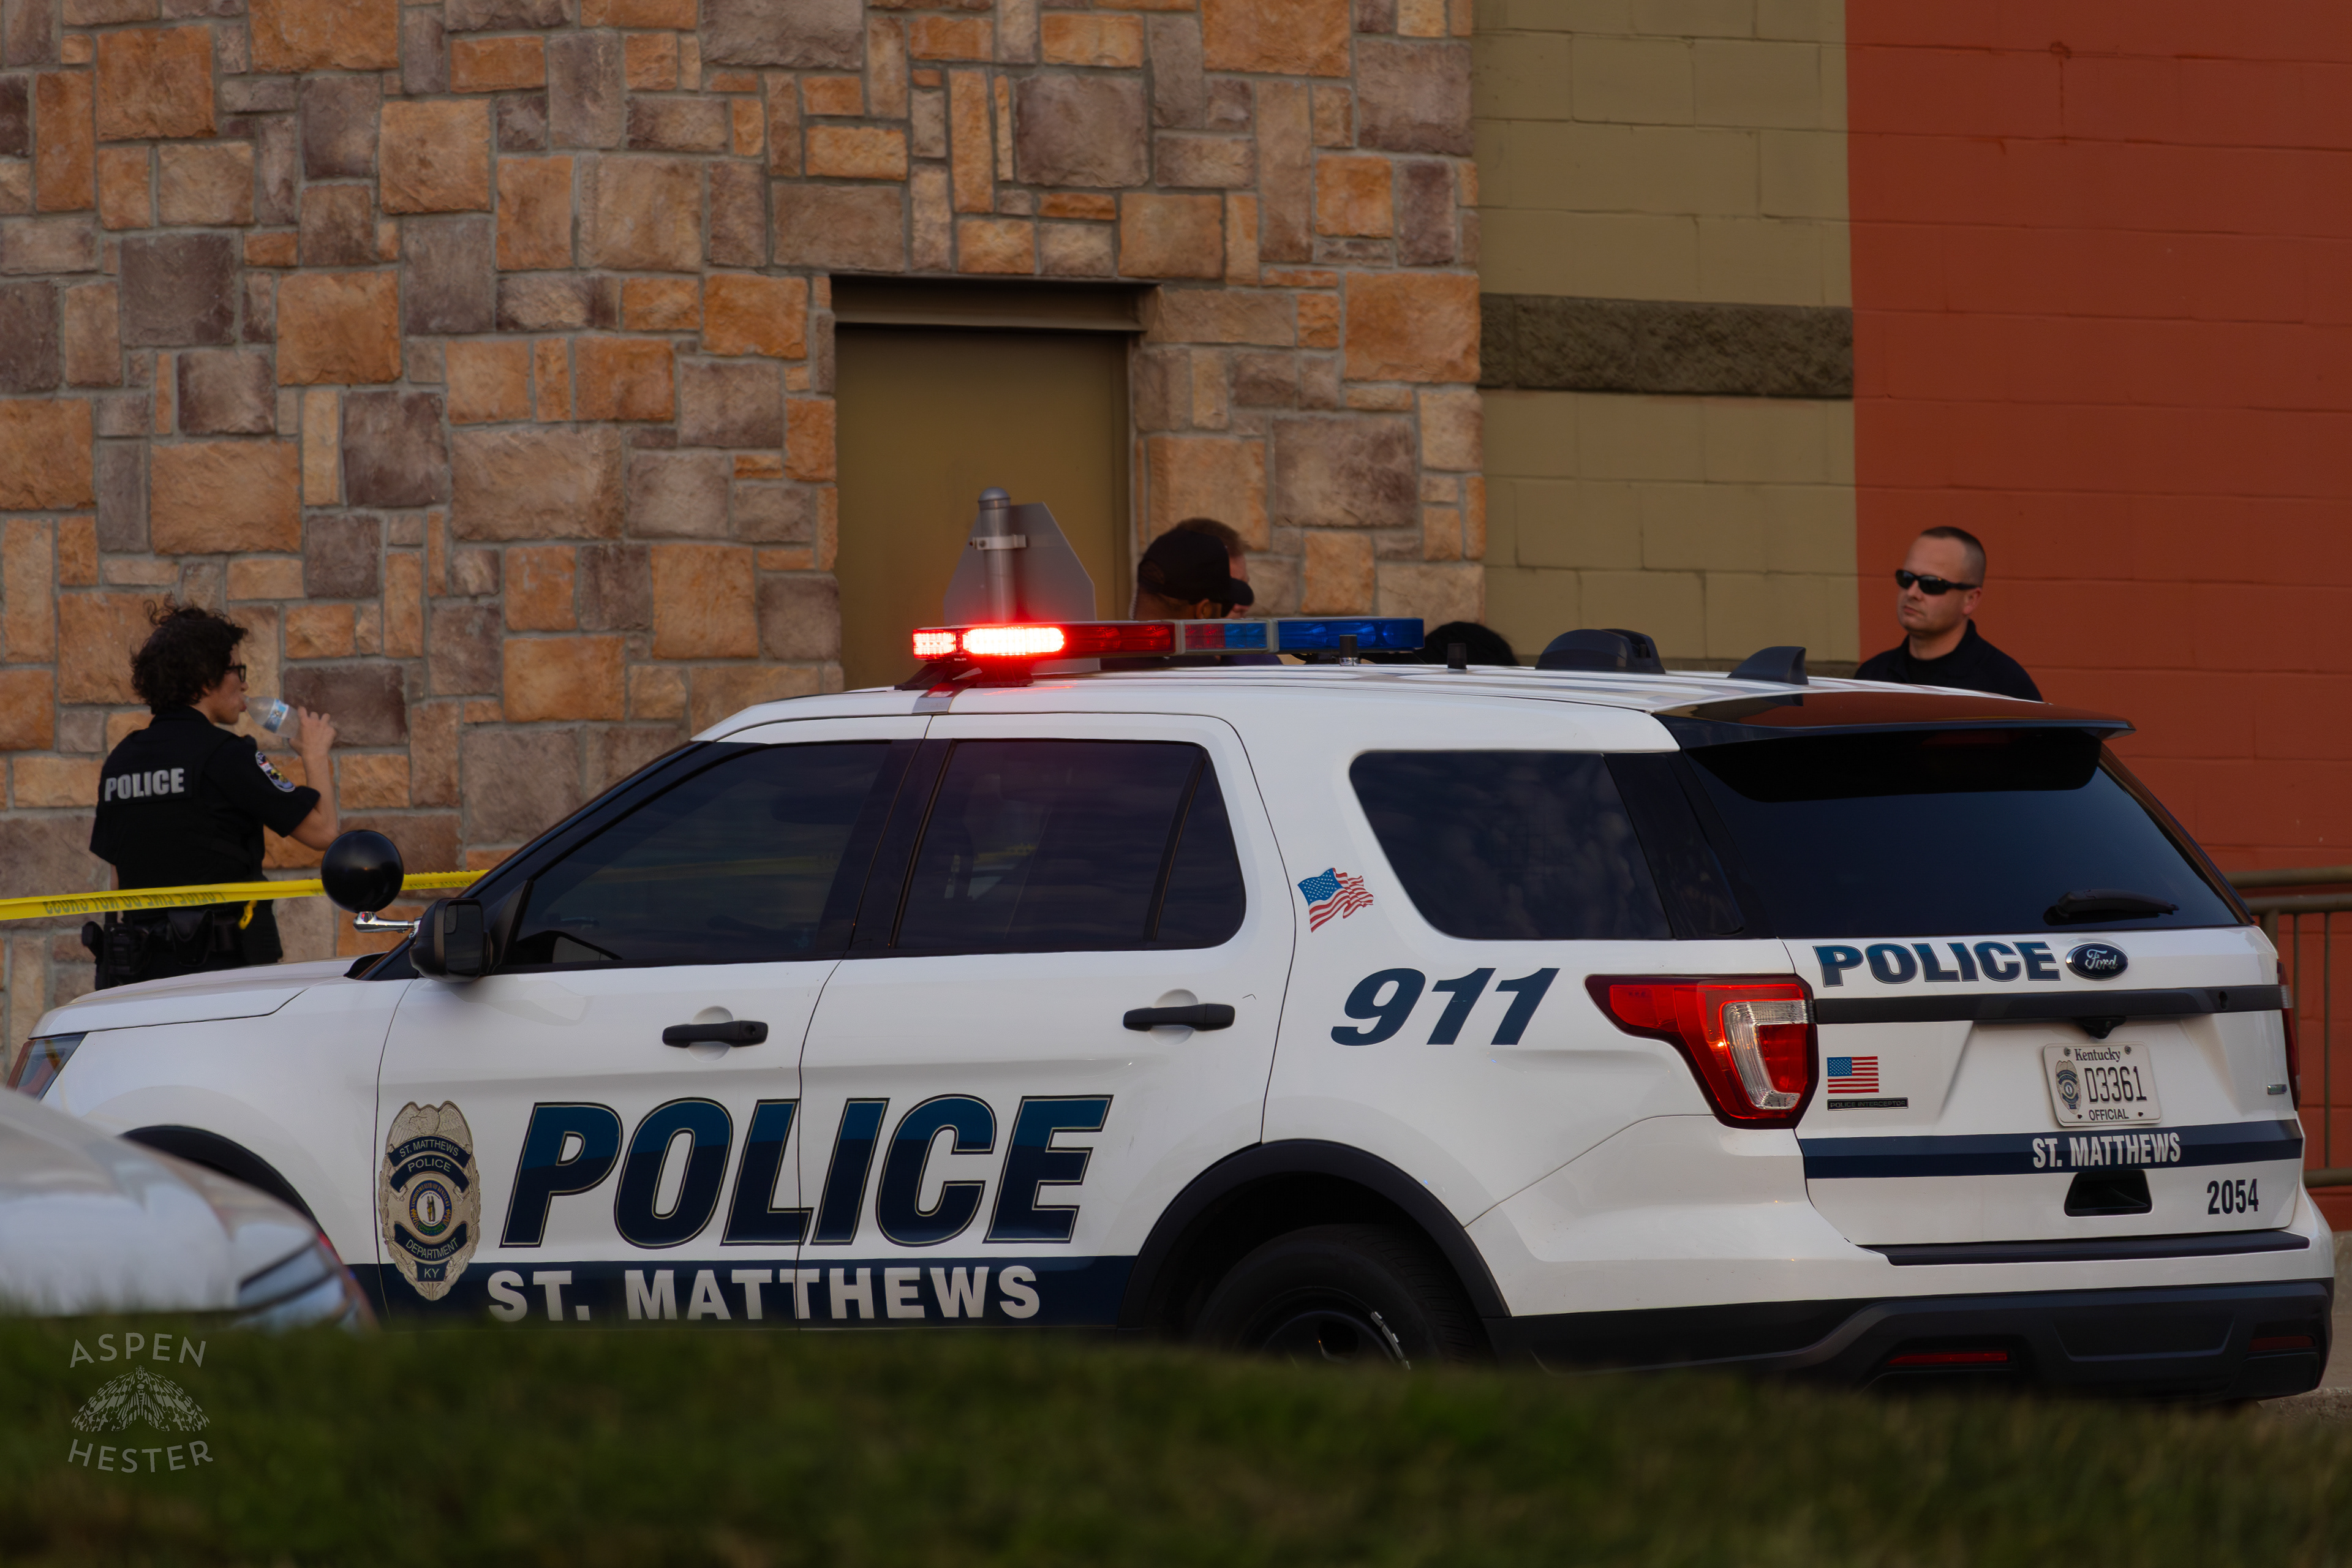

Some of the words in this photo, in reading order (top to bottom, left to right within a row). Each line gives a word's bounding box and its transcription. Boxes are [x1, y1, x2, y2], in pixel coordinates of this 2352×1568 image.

[104, 767, 185, 802] POLICE
[1812, 941, 2061, 988] POLICE
[2084, 949, 2118, 970] Ford
[1331, 967, 1560, 1046] 911
[2074, 1047, 2121, 1063] Kentucky
[2084, 1066, 2147, 1102] D3361
[2089, 1109, 2129, 1121] OFFICIAL
[399, 1145, 412, 1158] ST.
[413, 1139, 459, 1156] MATTHEWS
[407, 1158, 451, 1172] POLICE
[2032, 1137, 2062, 1168] ST.
[2069, 1132, 2181, 1167] MATTHEWS
[499, 1094, 1114, 1250] POLICE
[2206, 1178, 2259, 1215] 2054
[405, 1237, 458, 1259] DEPARTMENT
[424, 1268, 440, 1278] KY
[487, 1270, 590, 1322] ST.
[625, 1265, 1040, 1321] MATTHEWS
